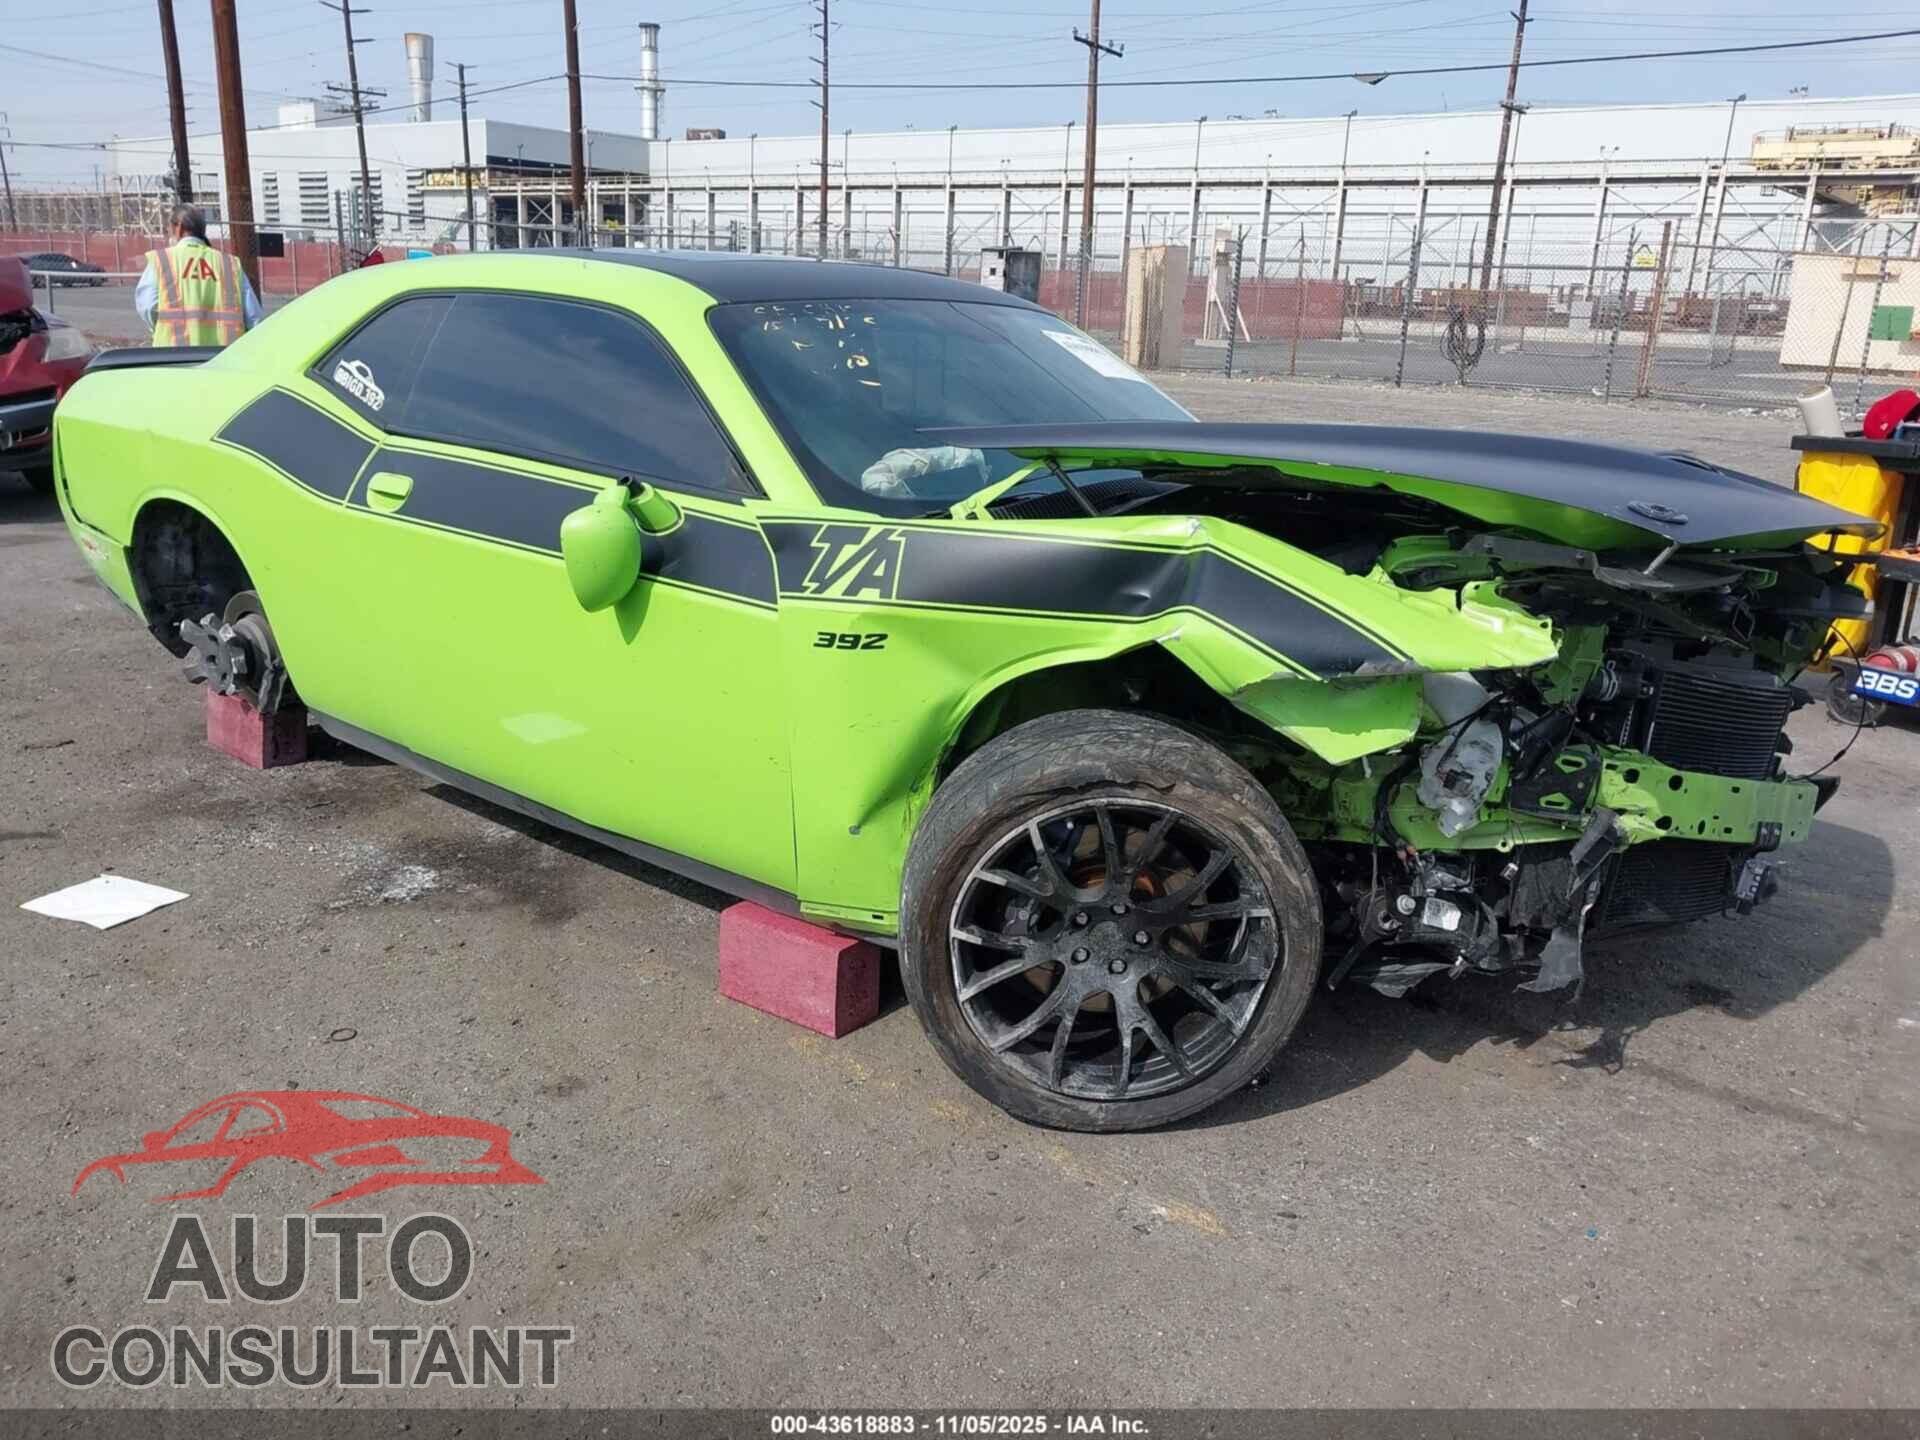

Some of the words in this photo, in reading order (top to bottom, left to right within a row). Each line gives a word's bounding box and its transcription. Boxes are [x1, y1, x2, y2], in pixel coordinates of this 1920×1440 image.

[802, 525, 906, 600] T/A
[813, 631, 889, 650] 392
[1855, 670, 1919, 699] BBS
